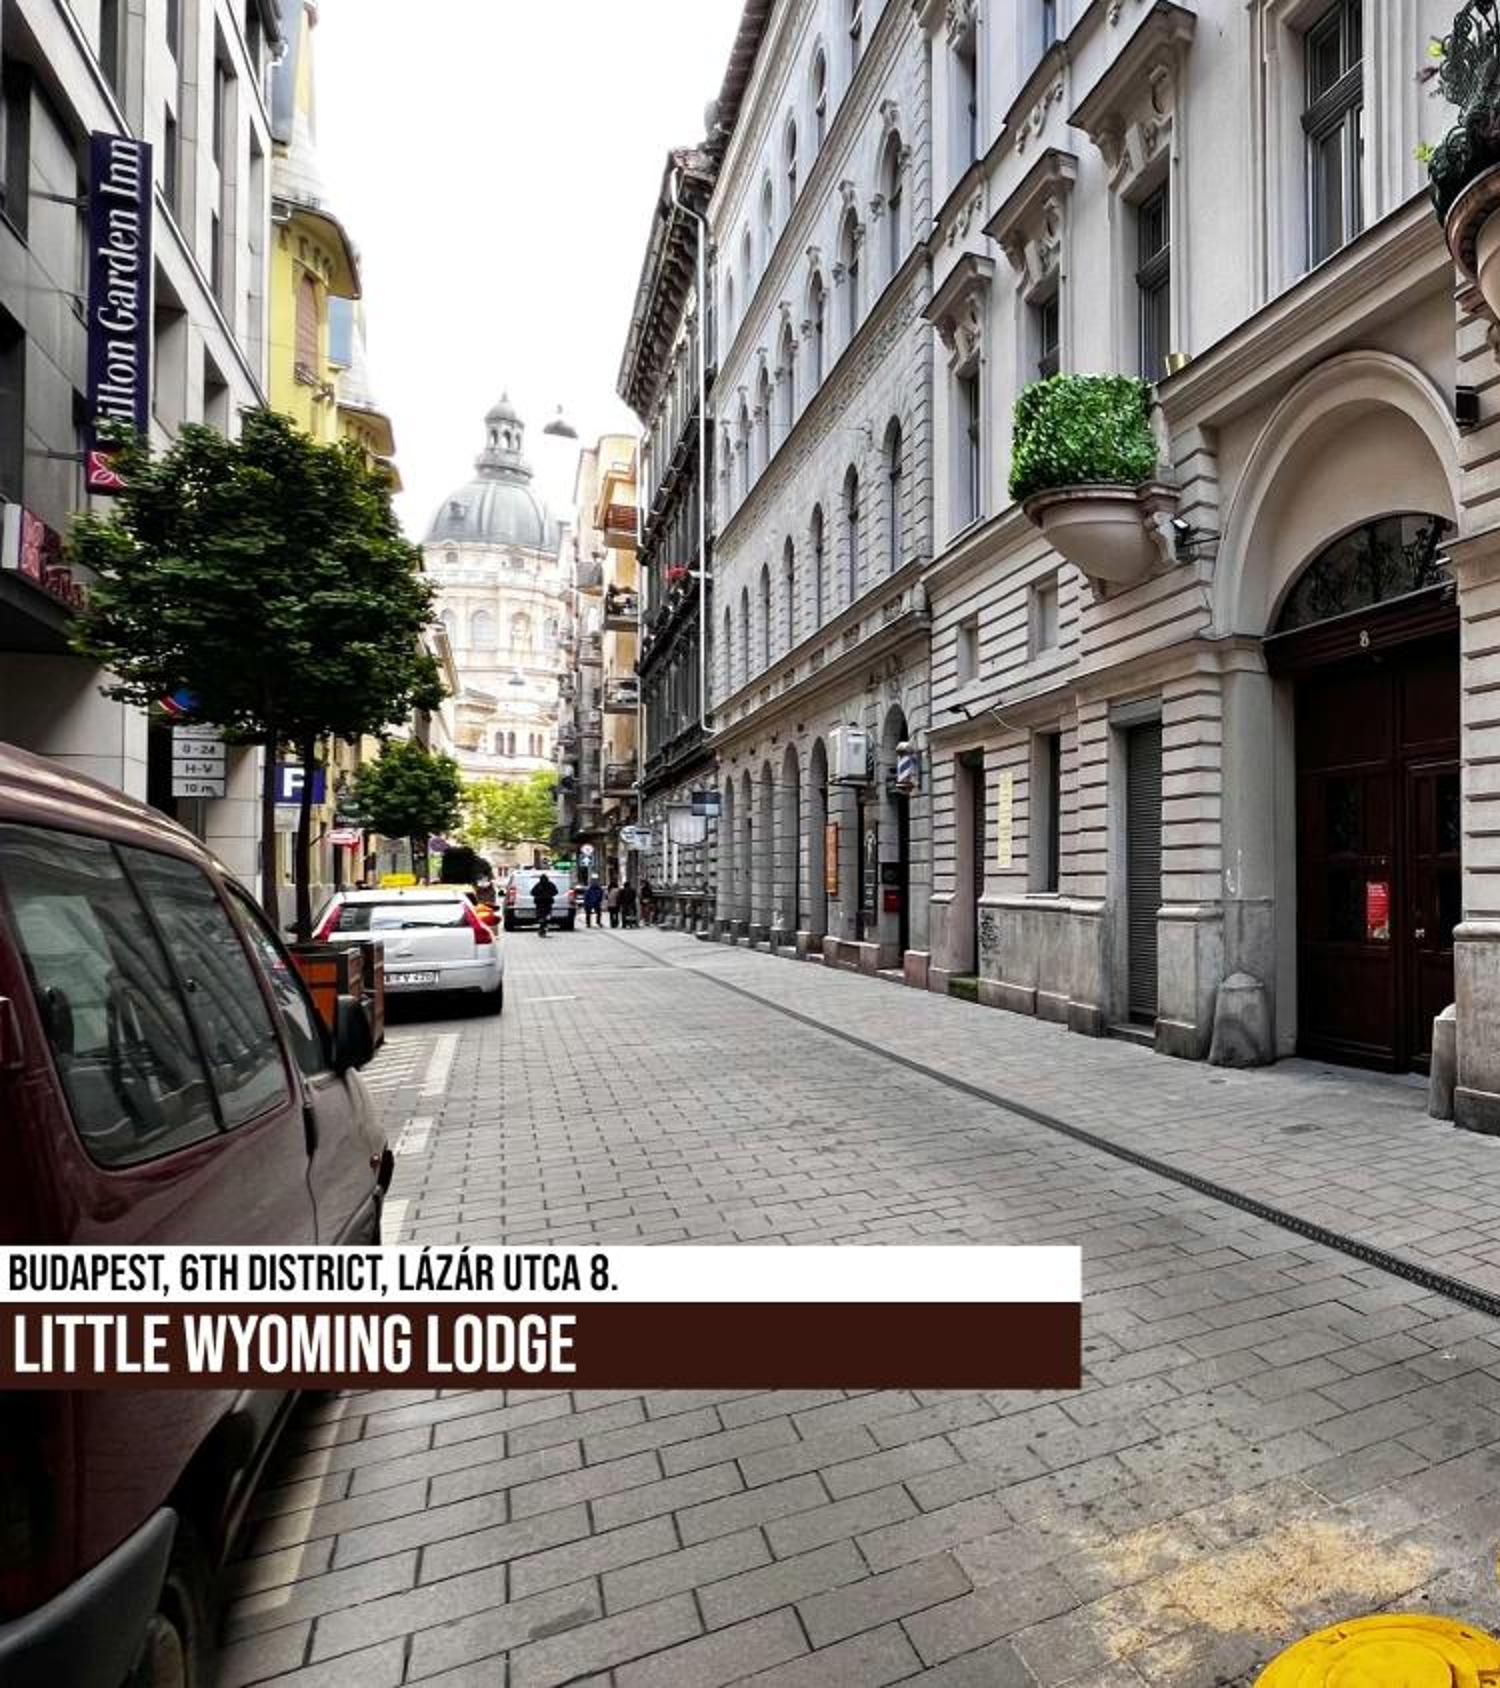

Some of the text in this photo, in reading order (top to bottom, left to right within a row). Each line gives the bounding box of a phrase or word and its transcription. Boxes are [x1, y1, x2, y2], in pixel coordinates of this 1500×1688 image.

[100, 139, 140, 203] Inn
[98, 207, 140, 332] Garden
[1359, 630, 1370, 647] 8
[184, 783, 197, 793] 10
